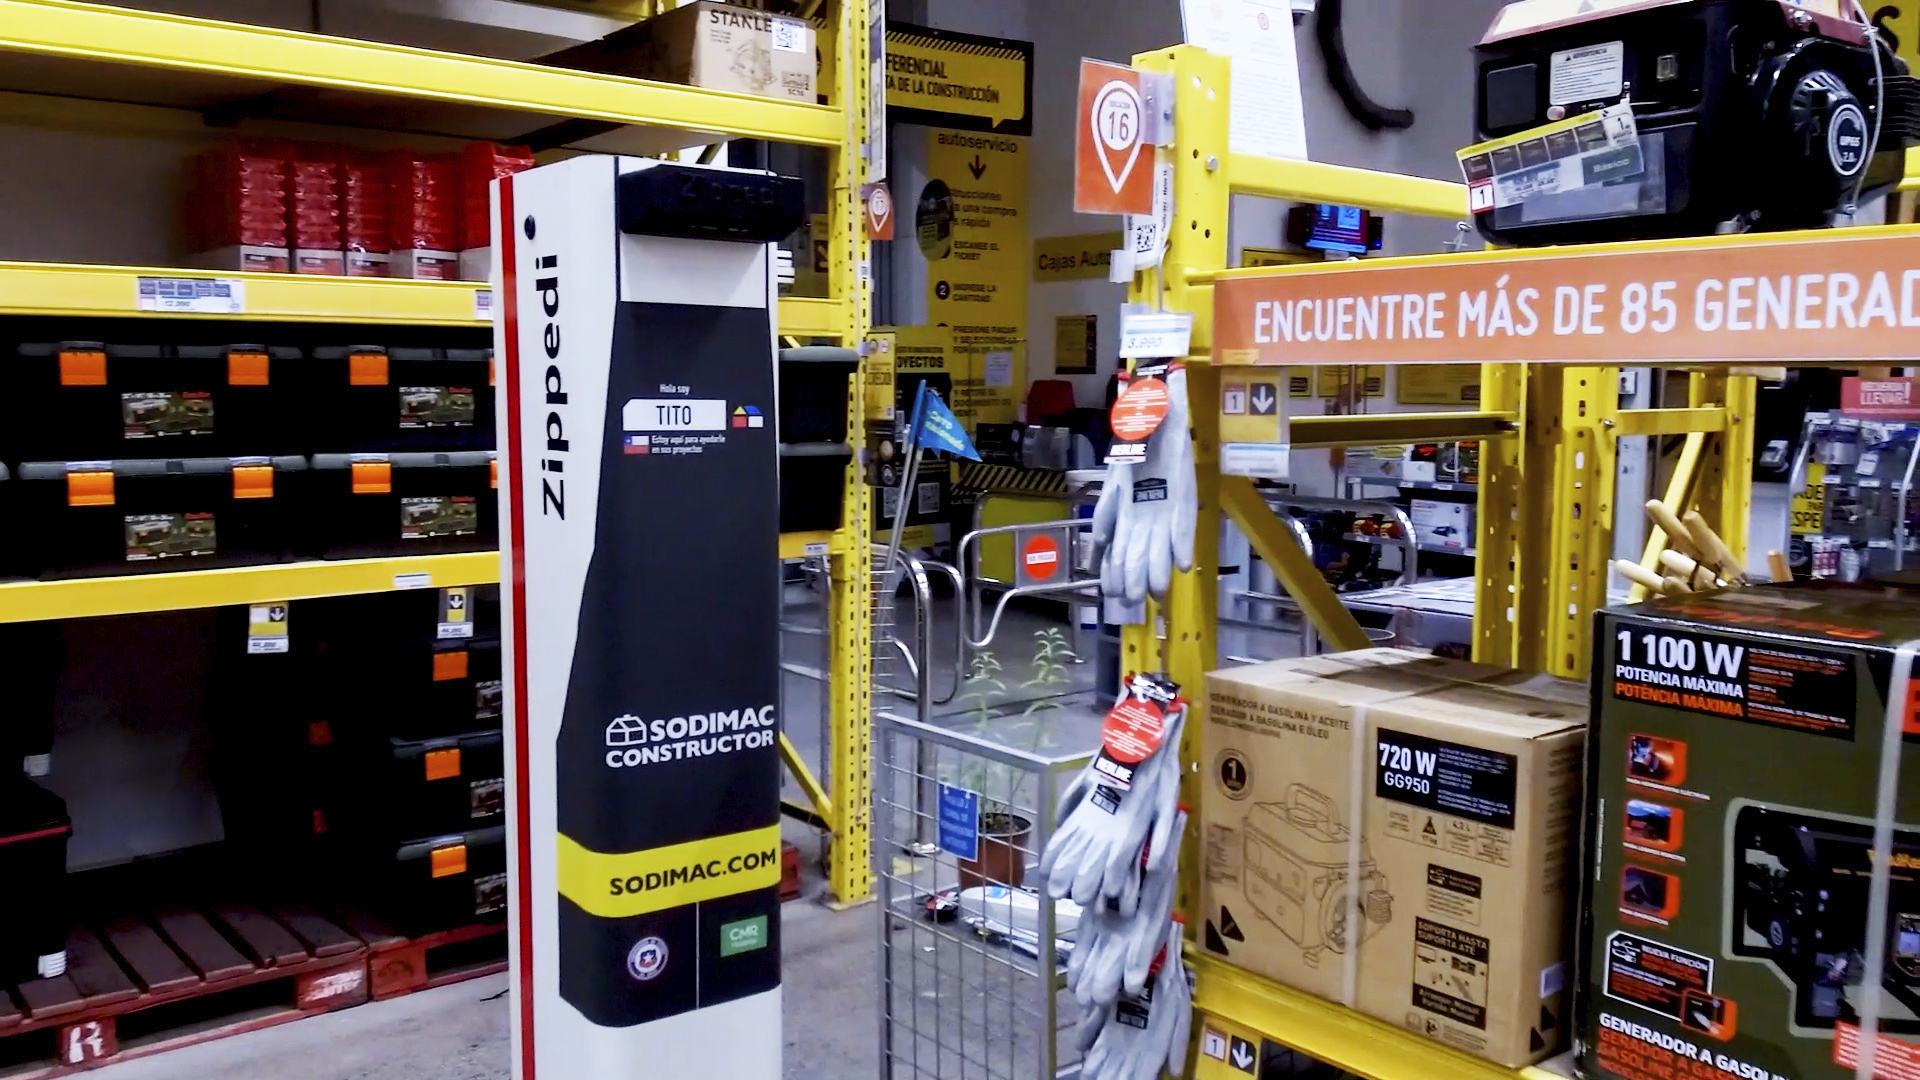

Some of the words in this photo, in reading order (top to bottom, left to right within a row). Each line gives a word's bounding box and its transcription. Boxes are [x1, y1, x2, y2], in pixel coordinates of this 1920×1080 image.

[1108, 111, 1130, 142] 16
[938, 132, 1018, 153] autoservicio
[1038, 254, 1076, 273] Cajas
[939, 285, 947, 296] 2
[1254, 291, 1447, 344] ENCUENTRE
[1457, 274, 1541, 338] MÁS
[1553, 283, 1607, 336] DE
[1620, 280, 1678, 334] 85
[535, 253, 569, 521] Zippedi
[659, 383, 677, 394] Hola
[677, 384, 691, 395] soy
[655, 405, 692, 426] TITO
[651, 435, 669, 445] Estoy
[1617, 629, 1632, 661] 1
[1642, 633, 1697, 673] 100
[1702, 640, 1745, 679] W
[1615, 663, 1682, 689] POTENCIA
[1682, 674, 1745, 699] MÁXIMA
[649, 704, 776, 742] SODIMAC
[1255, 715, 1298, 733] GASOLINA
[1267, 704, 1310, 722] GASOLINA
[1318, 715, 1350, 731] ACEITE
[605, 729, 775, 769] CONSTRUCTOR
[1378, 741, 1413, 772] 720
[1415, 749, 1438, 777] W
[1383, 771, 1431, 795] GG950
[609, 848, 777, 897] SODIMAC.COM
[729, 924, 760, 942] CMR
[1212, 1038, 1219, 1055] 1
[1599, 1012, 1698, 1060] GENERADOR
[1700, 1048, 1713, 1066] A
